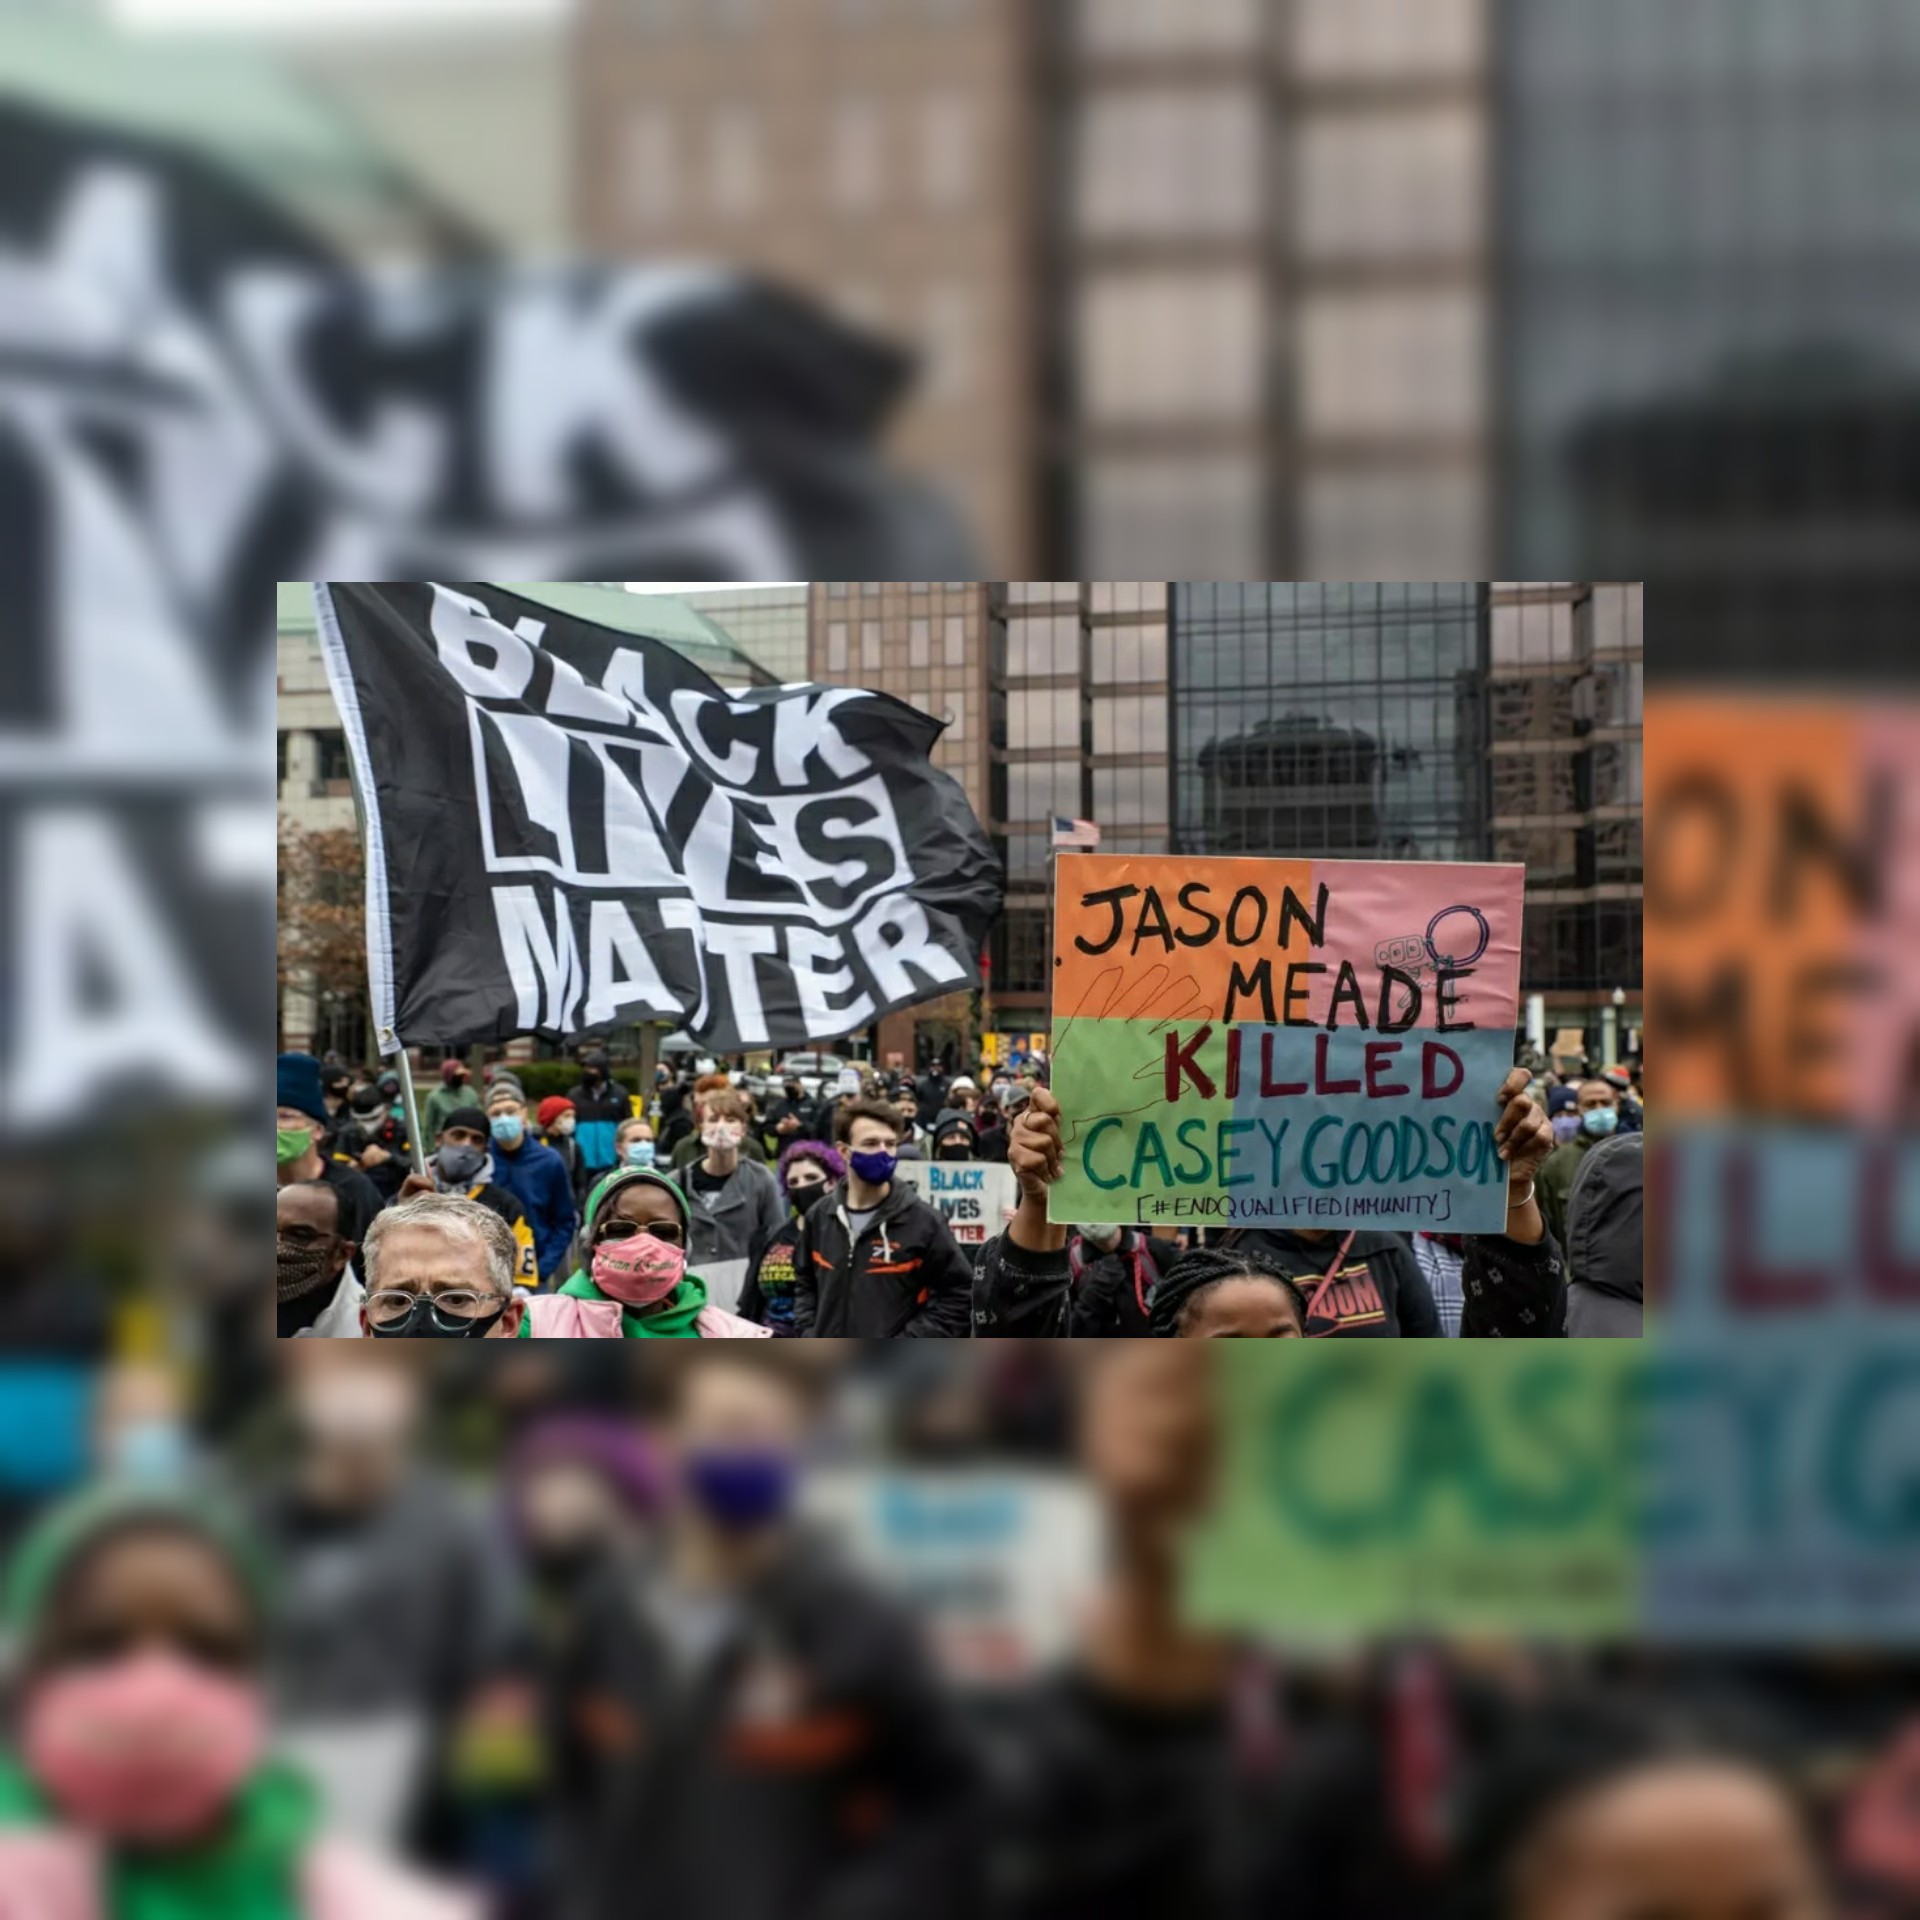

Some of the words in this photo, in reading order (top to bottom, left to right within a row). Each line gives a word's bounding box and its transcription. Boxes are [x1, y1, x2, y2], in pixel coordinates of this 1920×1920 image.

[430, 580, 873, 788] BLACK
[474, 704, 900, 912] LIVES
[1074, 882, 1330, 956] JASON
[491, 885, 968, 1043] MATTER
[1221, 957, 1476, 1034] MEADE
[1163, 1024, 1466, 1102] KILLED
[929, 1167, 985, 1191] BLACK
[1082, 1114, 1291, 1190] CASEY
[1300, 1114, 1505, 1189] GOODSON
